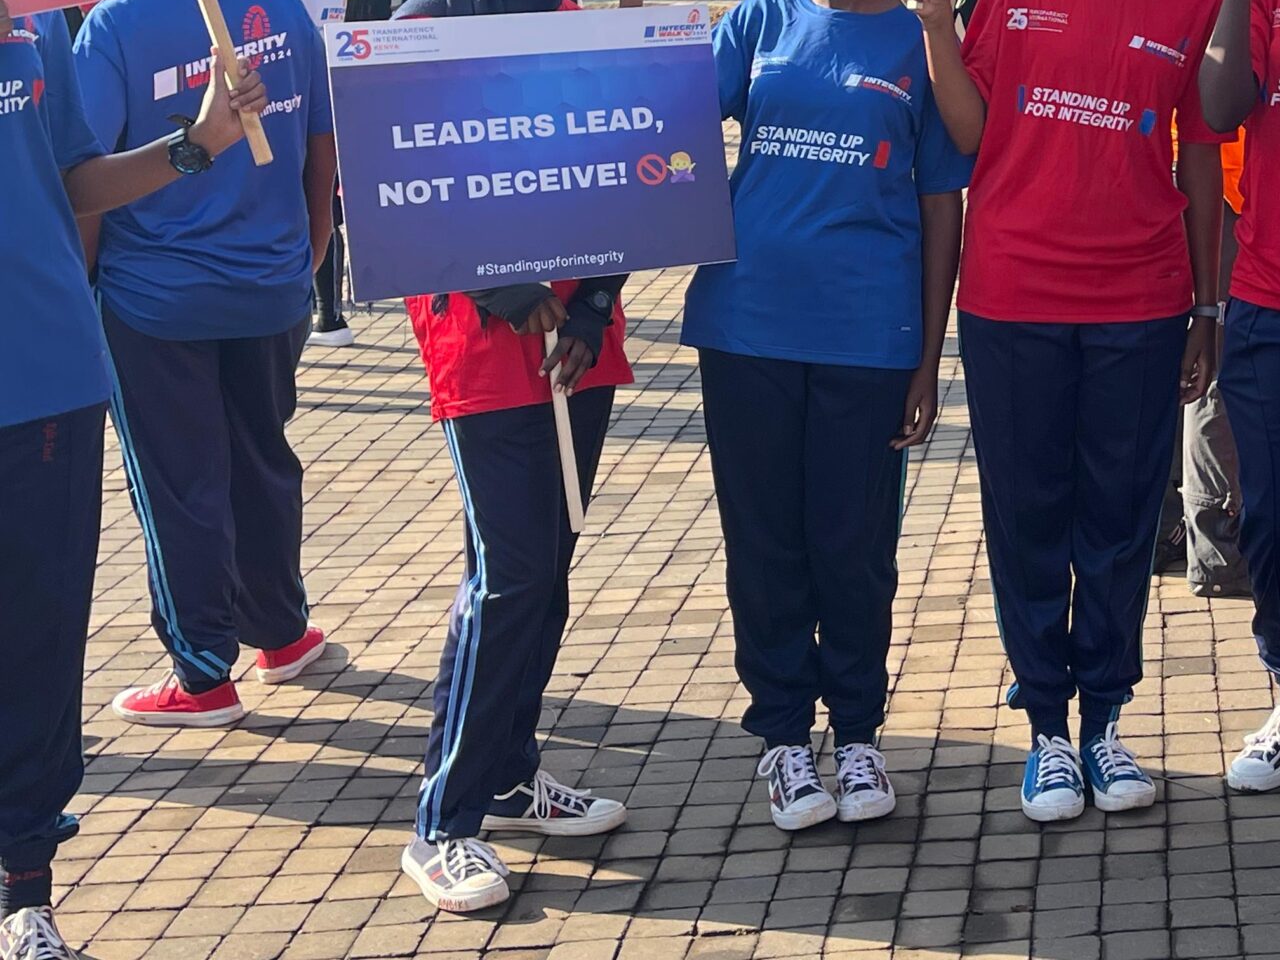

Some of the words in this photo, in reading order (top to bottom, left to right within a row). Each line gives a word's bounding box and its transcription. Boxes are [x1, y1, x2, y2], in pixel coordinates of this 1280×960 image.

[372, 26, 435, 35] TRANSPARENCY
[658, 23, 706, 31] INTEGRITY
[263, 49, 291, 64] 2024
[335, 29, 372, 60] 25
[863, 76, 912, 101] INTEGRITY
[1032, 87, 1107, 112] STANDING
[1110, 100, 1131, 115] UP
[391, 114, 555, 149] LEADERS
[566, 106, 664, 135] LEAD,
[1024, 101, 1054, 118] FOR
[1057, 108, 1134, 132] INTEGRITY
[756, 126, 836, 146] STANDING
[840, 133, 864, 149] UP
[750, 140, 781, 156] FOR
[782, 143, 871, 167] INTEGRITY
[378, 177, 454, 207] NOT
[467, 161, 627, 199] DECEIVE!
[476, 250, 625, 276] #Standingupforintegrity
